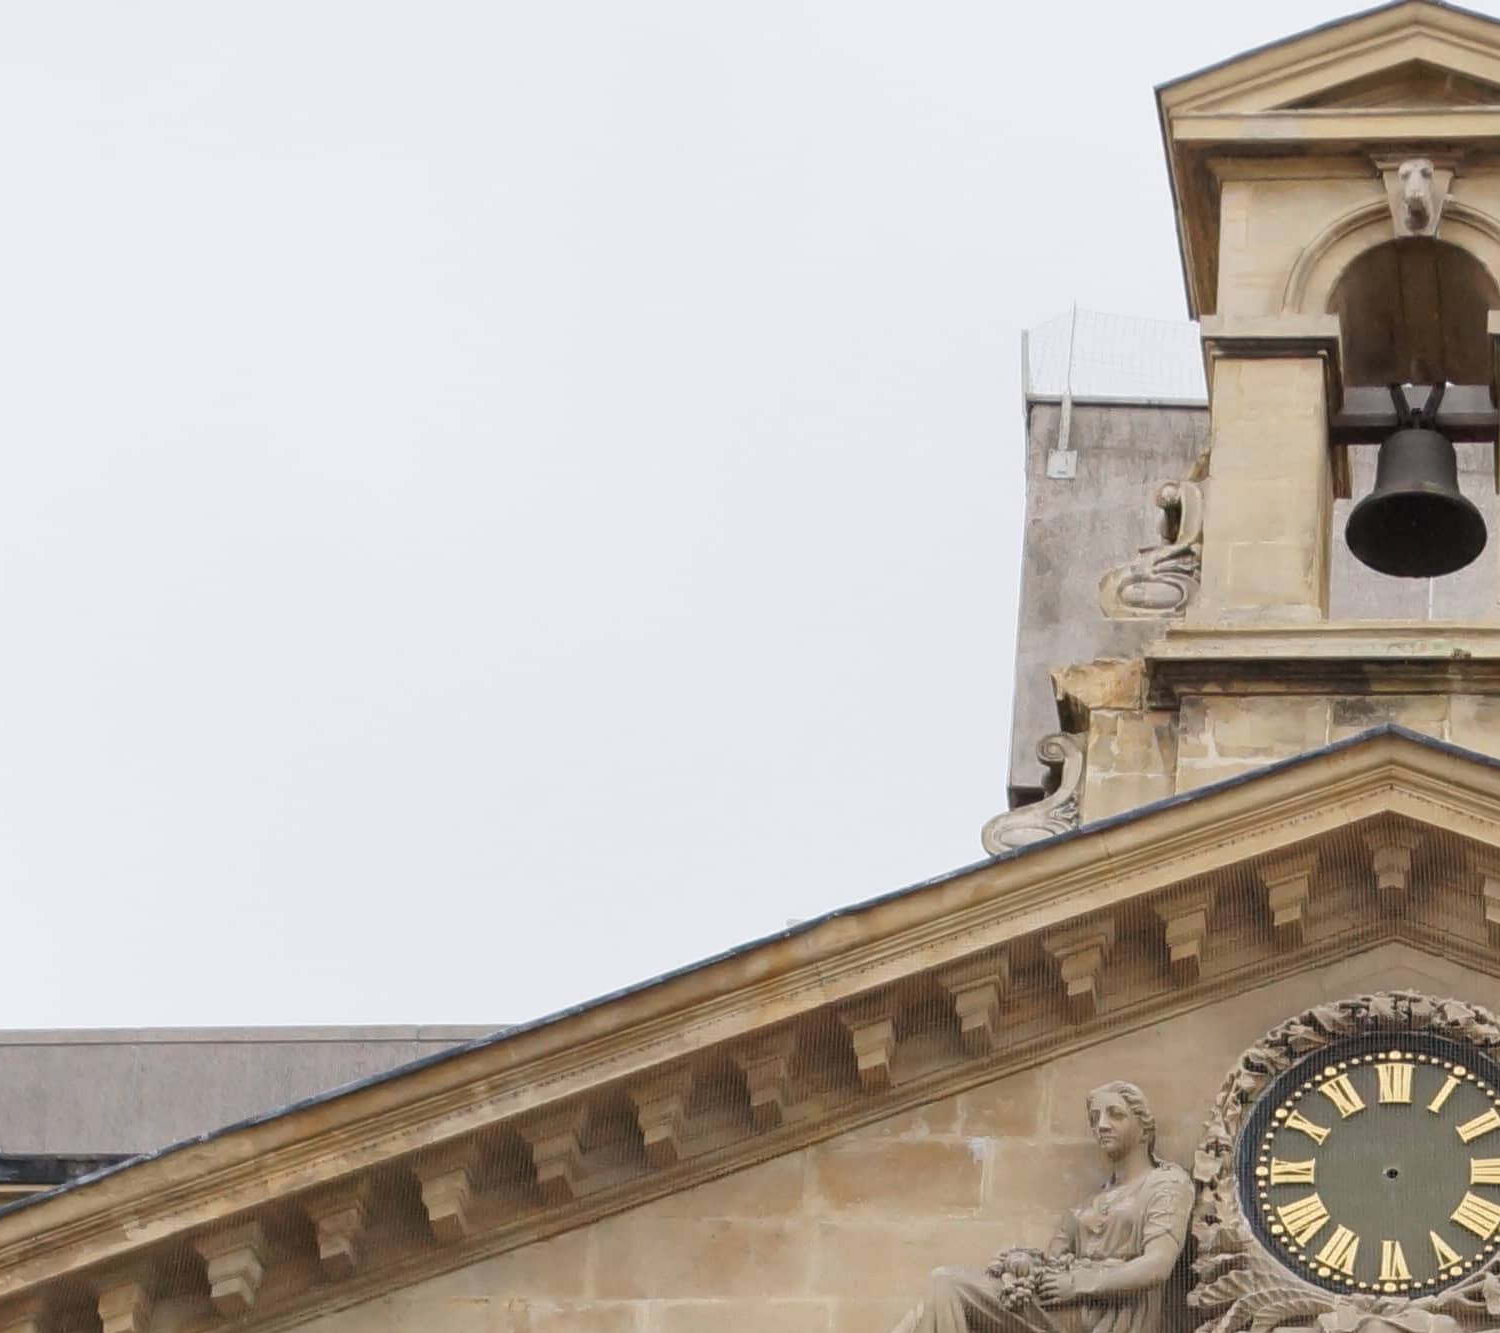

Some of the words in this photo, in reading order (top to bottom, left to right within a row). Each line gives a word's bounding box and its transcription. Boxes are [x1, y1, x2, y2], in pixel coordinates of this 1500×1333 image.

[1318, 1073, 1366, 1118] XI
[1375, 1063, 1415, 1103] XII
[1428, 1075, 1461, 1113] I
[1285, 1110, 1331, 1145] X
[1270, 1157, 1315, 1185] IX
[1277, 1192, 1330, 1247] VIII
[1315, 1224, 1359, 1275] VII
[1379, 1240, 1412, 1280] VI
[1429, 1230, 1463, 1270] V
